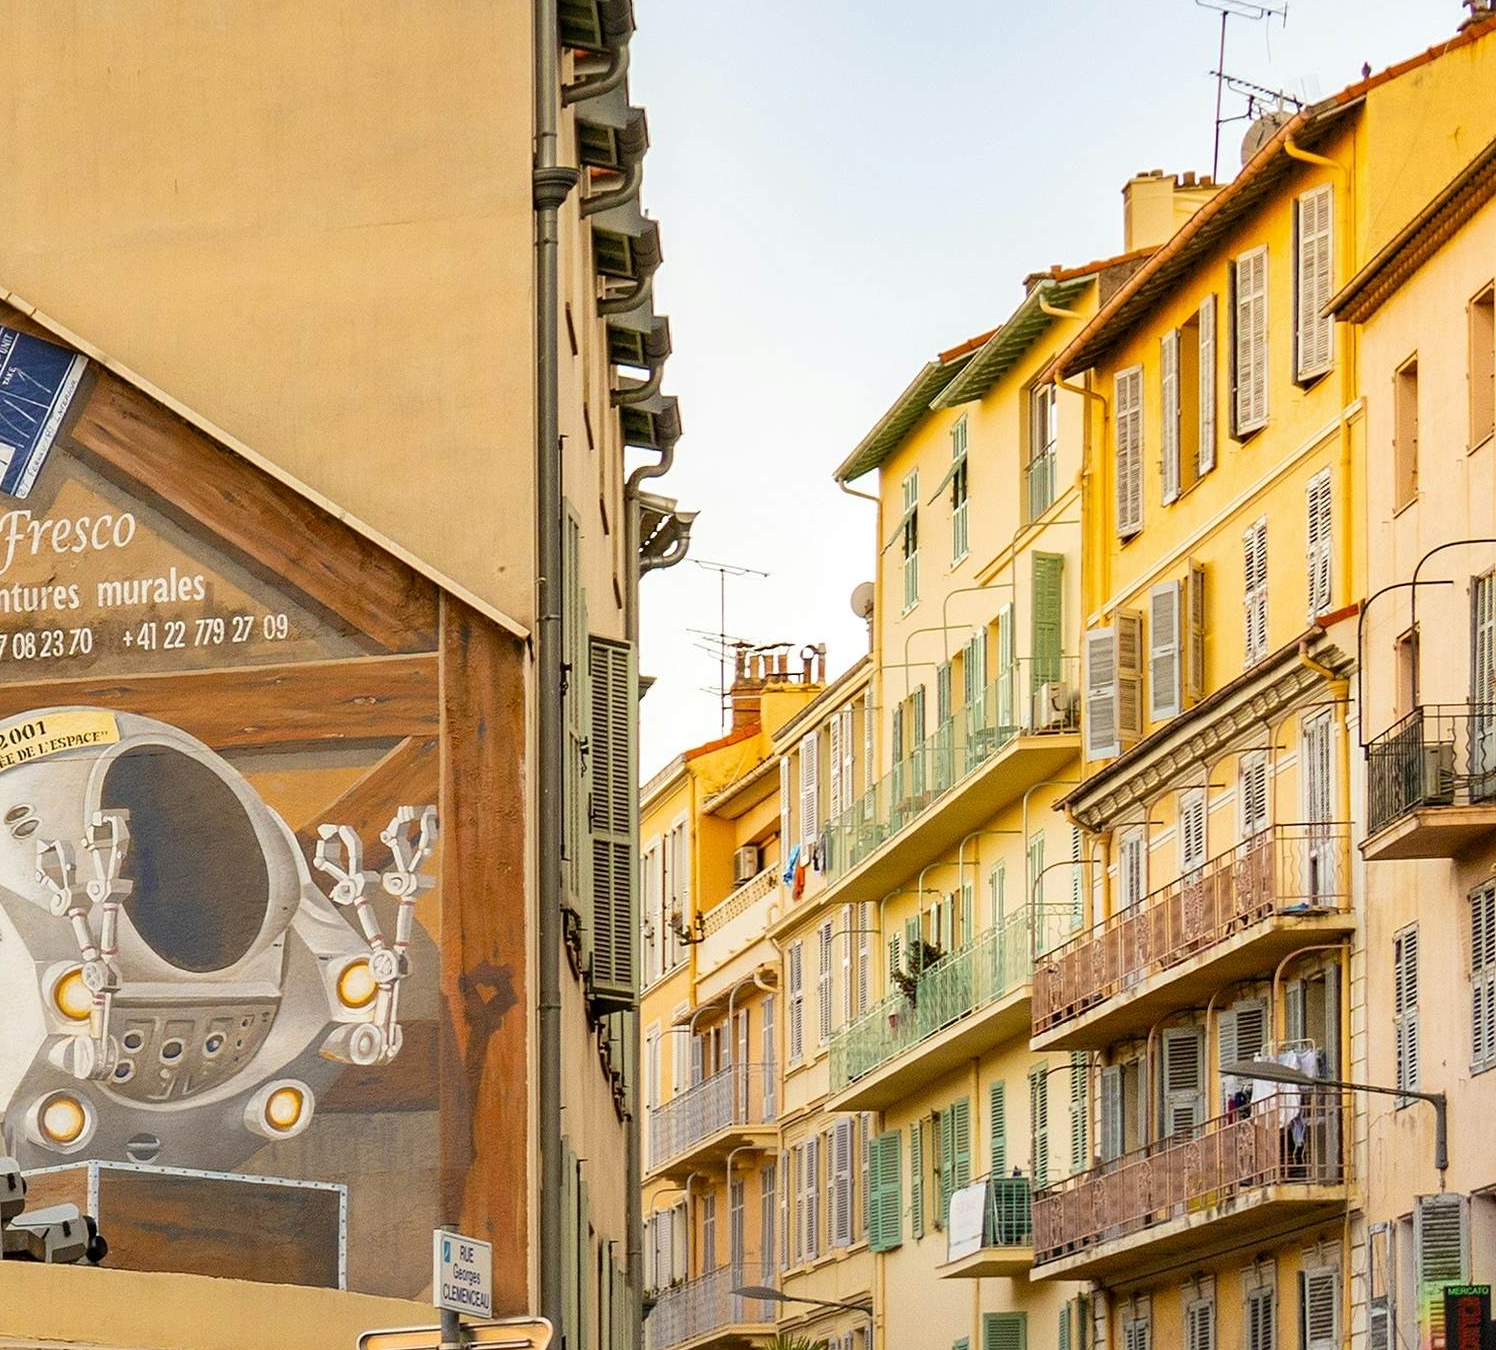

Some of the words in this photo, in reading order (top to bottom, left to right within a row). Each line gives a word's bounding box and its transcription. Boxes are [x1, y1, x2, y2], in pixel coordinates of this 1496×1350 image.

[97, 567, 205, 608] murales
[12, 633, 36, 660] 08
[40, 629, 64, 658] 23
[68, 627, 93, 656] 70
[123, 622, 157, 651] +41
[163, 621, 186, 649] 22
[194, 617, 225, 647] 779
[232, 616, 255, 643] 27
[263, 614, 288, 640] 09
[17, 746, 36, 762] DE
[459, 1245, 474, 1263] RUE
[453, 1263, 481, 1286] Georges
[442, 1283, 490, 1309] CLEMENCEAU
[1448, 1287, 1489, 1296] MERCATO
